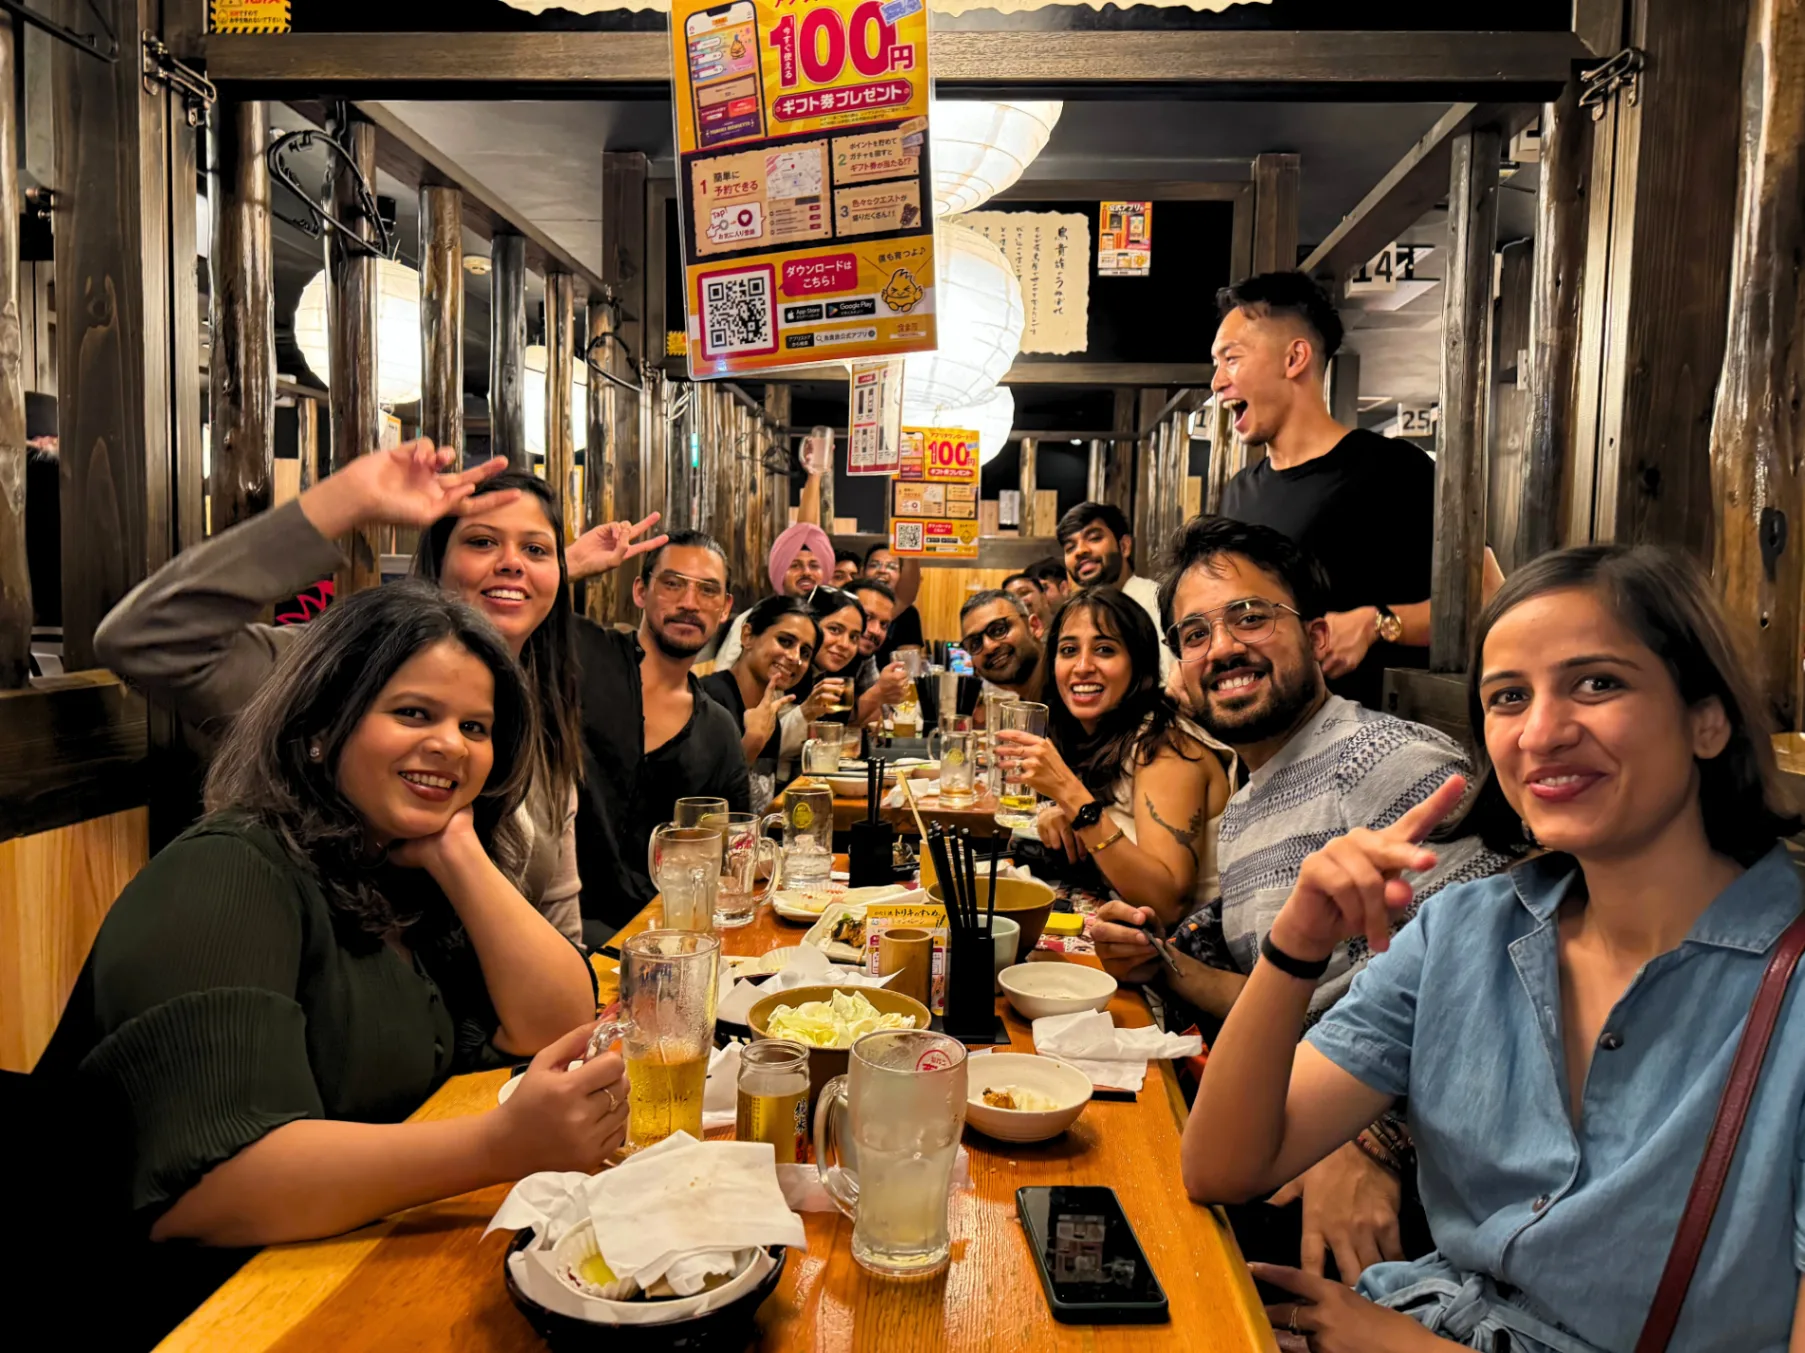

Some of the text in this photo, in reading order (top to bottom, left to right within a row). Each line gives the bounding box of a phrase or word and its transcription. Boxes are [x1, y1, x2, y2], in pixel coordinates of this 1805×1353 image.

[770, 1, 915, 87] 100円
[782, 27, 793, 79] 今すぐ使える
[782, 85, 902, 114] ギフト券プレゼント
[838, 154, 847, 166] 2
[713, 171, 740, 182] 簡単に
[700, 180, 706, 194] 1
[714, 180, 758, 196] 予約できる
[840, 205, 849, 217] 3
[786, 260, 852, 277] ダウンロードは
[803, 275, 835, 288] こちら!
[860, 301, 873, 309] Play
[1402, 410, 1430, 430] 25
